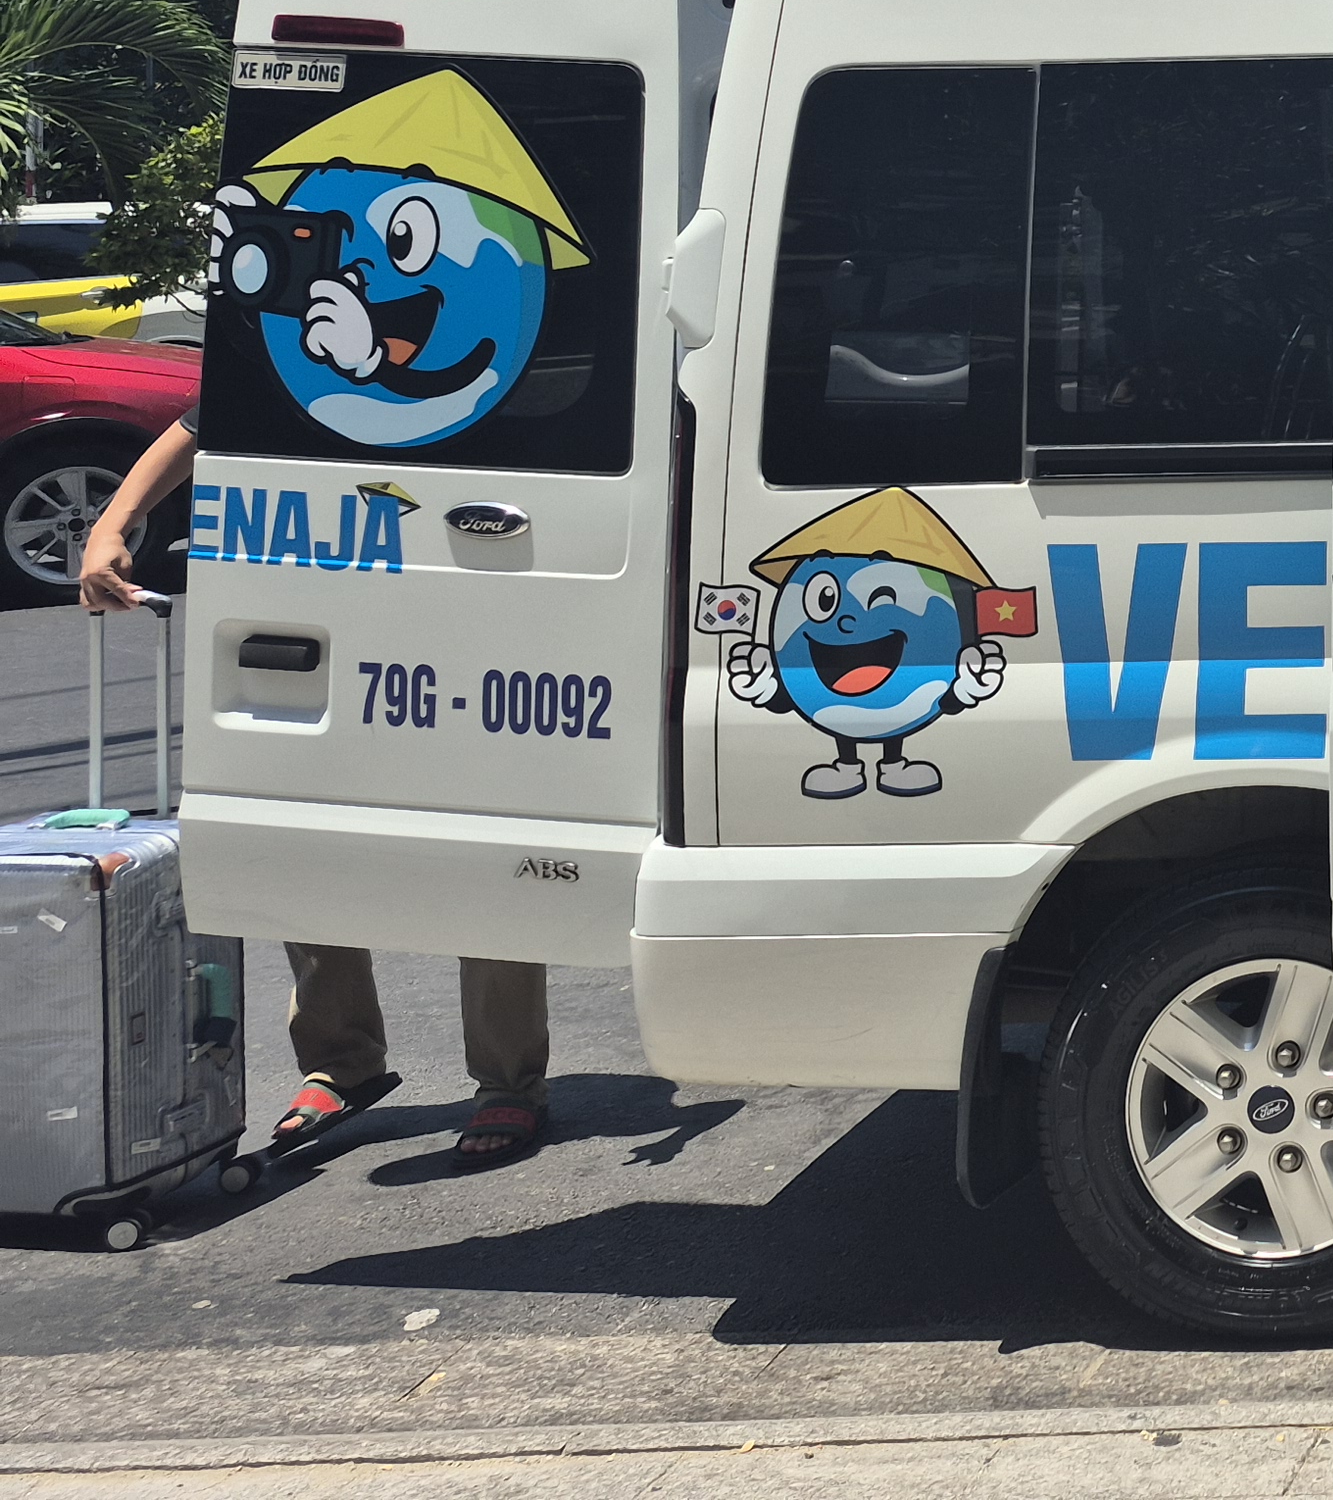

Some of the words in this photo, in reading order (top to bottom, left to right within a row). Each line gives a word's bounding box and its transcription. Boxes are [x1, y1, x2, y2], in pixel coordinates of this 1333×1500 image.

[238, 61, 258, 80] XE
[261, 61, 293, 84] HỢP
[188, 484, 403, 574] ENAJA
[458, 508, 506, 532] Ford
[1046, 540, 1328, 762] VE
[358, 661, 437, 728] 79G
[481, 668, 612, 740] 00092
[513, 857, 580, 883] ABS
